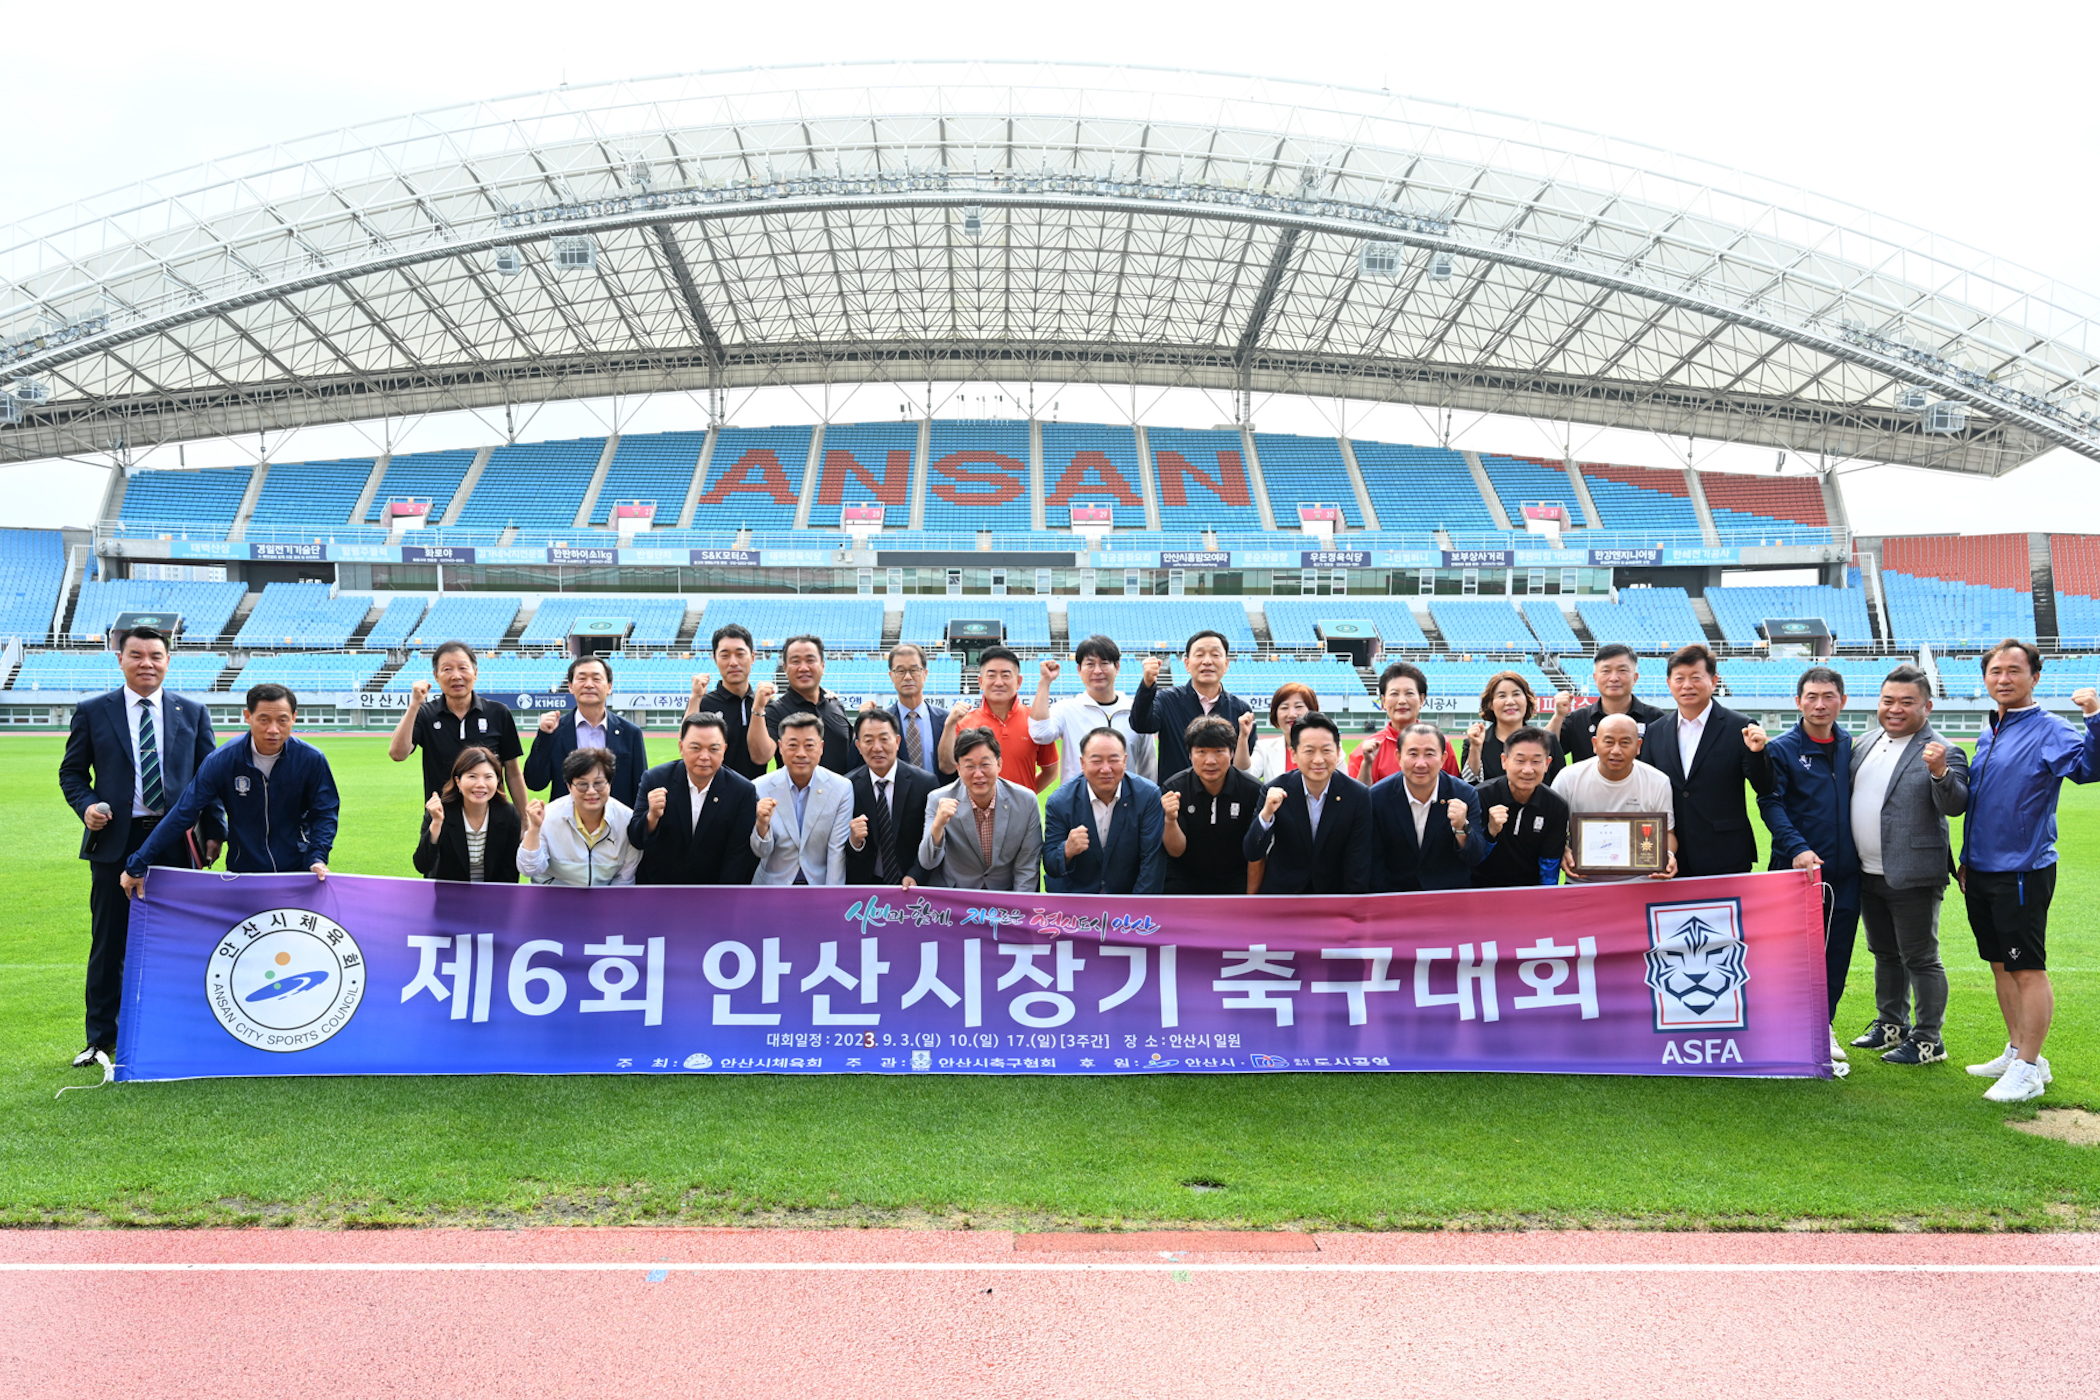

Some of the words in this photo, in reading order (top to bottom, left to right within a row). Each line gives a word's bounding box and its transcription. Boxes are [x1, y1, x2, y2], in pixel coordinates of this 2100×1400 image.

[700, 449, 1251, 507] ANSAN
[256, 544, 320, 555] 경일전기기술단
[424, 548, 453, 558] 화로야
[1594, 550, 1656, 560] 한강엔지니어링
[701, 551, 749, 561] S&K모터스
[535, 699, 567, 708] K1MED
[1111, 913, 1161, 936] 안산
[401, 933, 665, 1027] 제6회
[702, 935, 1179, 1028] 안산시장기
[1212, 935, 1599, 1028] 축구대회
[213, 983, 237, 1024] ANSAN
[235, 1022, 264, 1042] CITY
[266, 1030, 319, 1045] SPORTS
[321, 986, 359, 1034] COUNCIL
[1661, 1038, 1743, 1065] ASFA
[720, 1057, 822, 1068] 안산시체육회
[938, 1056, 1056, 1068] 안산시축구협회
[1185, 1057, 1236, 1068] 안산시
